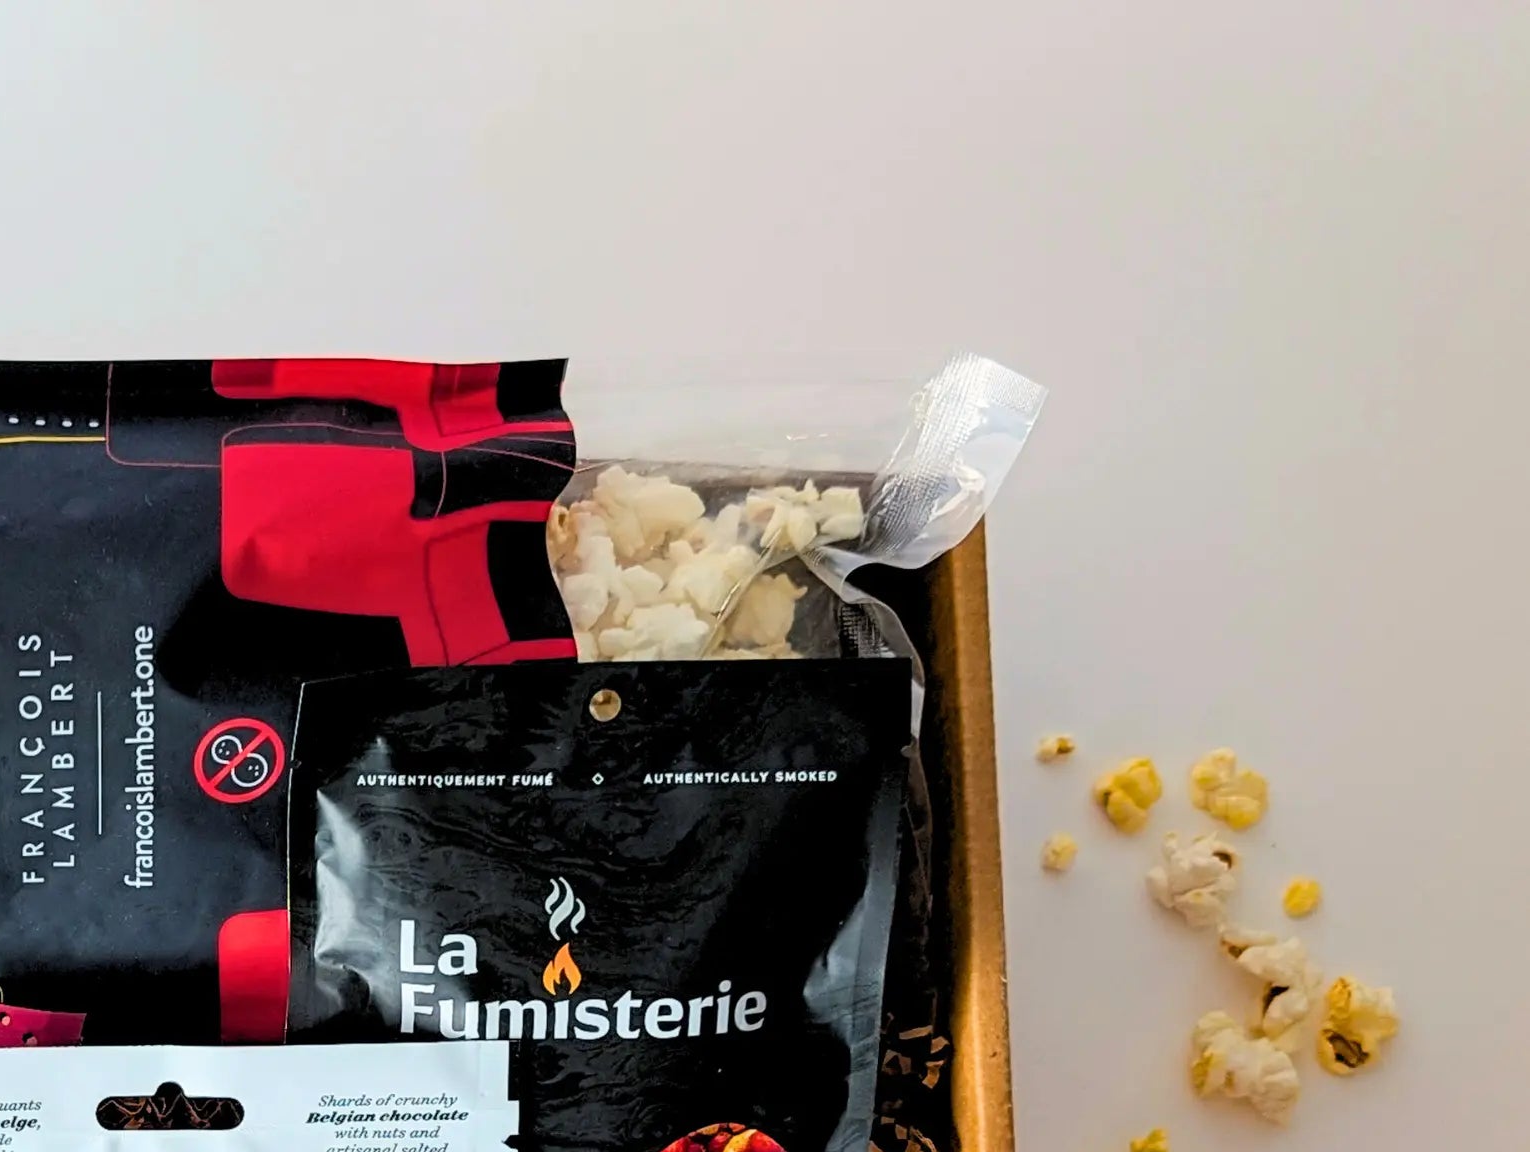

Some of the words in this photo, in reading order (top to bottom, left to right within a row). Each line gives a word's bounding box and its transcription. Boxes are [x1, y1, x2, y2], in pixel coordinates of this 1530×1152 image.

[18, 634, 46, 883] FRANÇOIS
[50, 650, 75, 867] LAMBERT
[124, 625, 155, 888] francoislambert.one
[356, 774, 507, 788] AUTHENTIQUEMENT
[511, 772, 554, 787] FUMÉ
[643, 771, 770, 785] AUTHENTICALLY
[774, 770, 838, 783] SMOKED
[400, 919, 479, 975] La
[400, 980, 768, 1040] Fumisterie
[305, 1111, 376, 1125] Belgian
[379, 1109, 469, 1122] chocolate
[318, 1094, 372, 1107] Shards
[375, 1093, 395, 1107] of
[395, 1093, 458, 1109] crunchy
[334, 1126, 369, 1139] with
[372, 1127, 407, 1139] nuts
[409, 1126, 441, 1139] and
